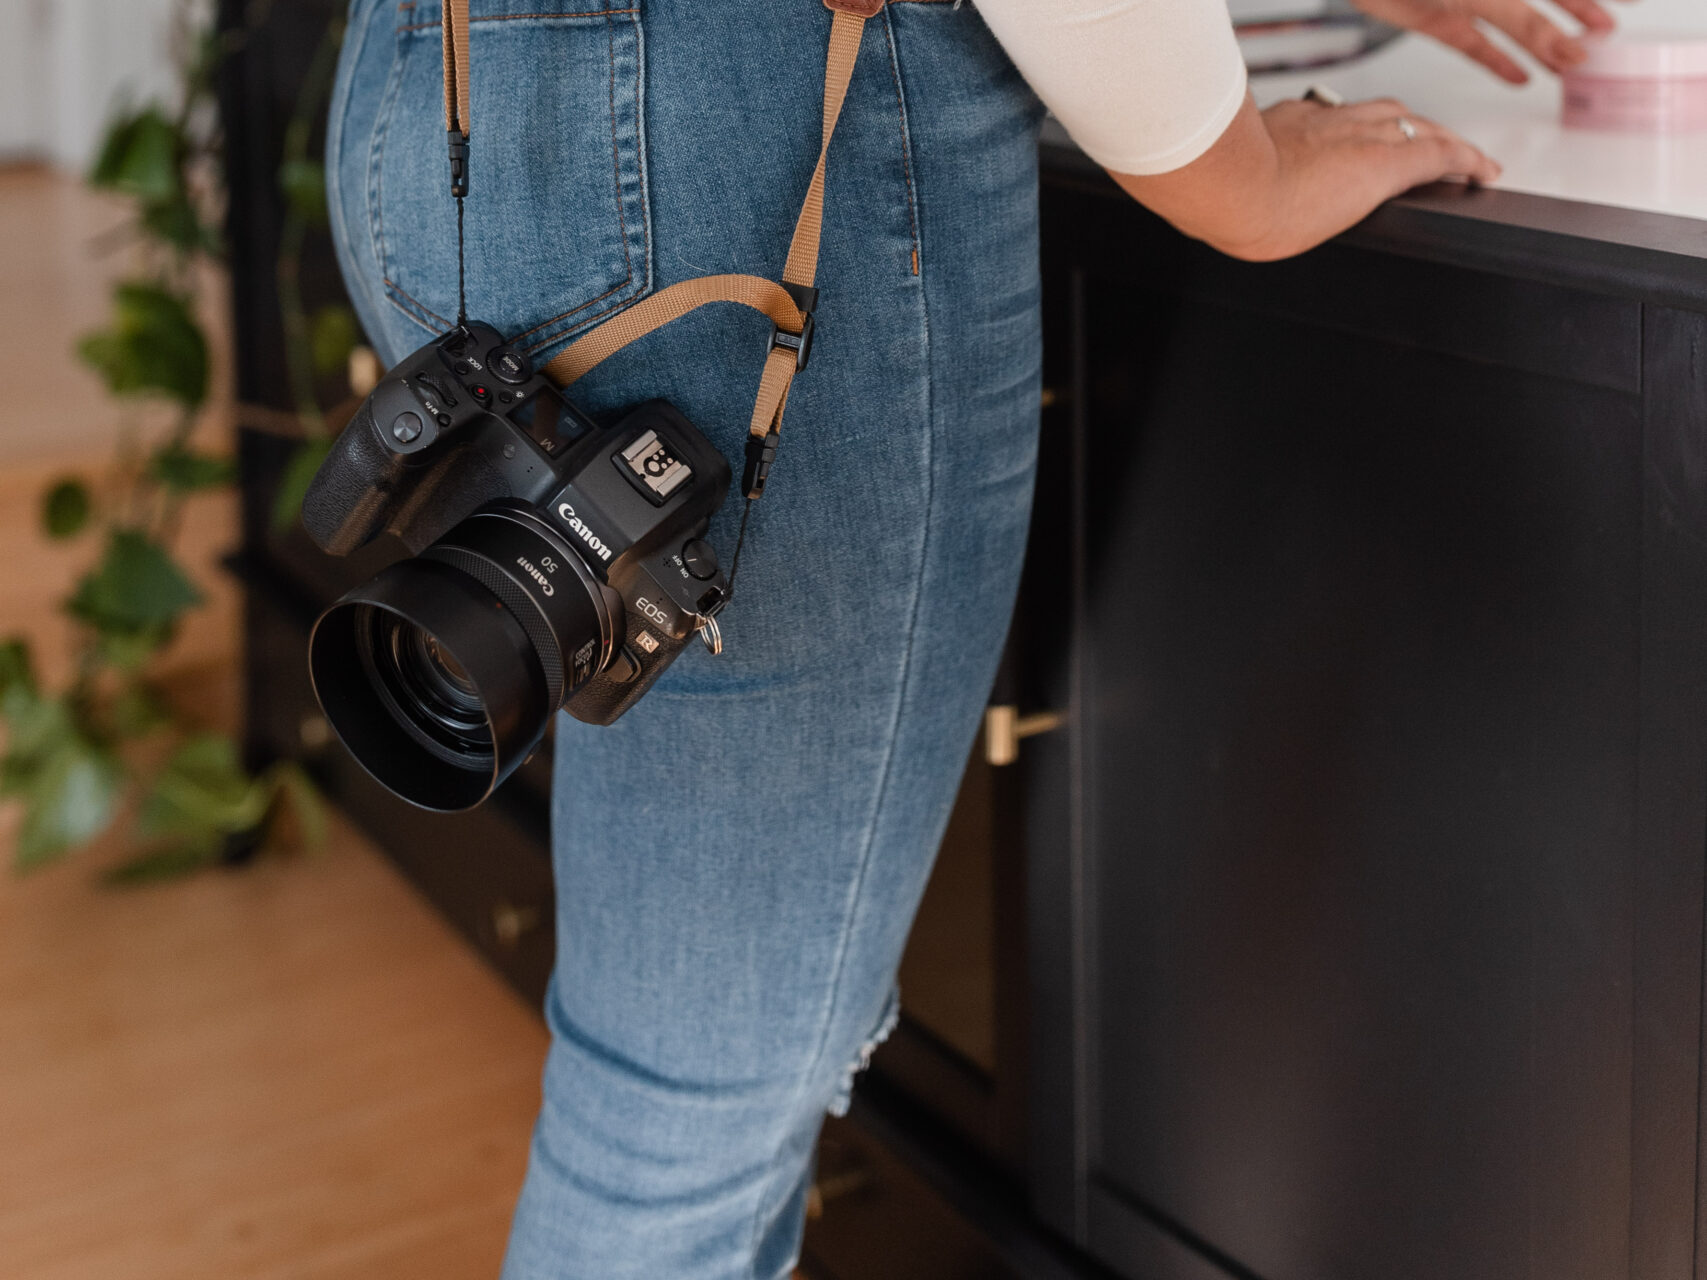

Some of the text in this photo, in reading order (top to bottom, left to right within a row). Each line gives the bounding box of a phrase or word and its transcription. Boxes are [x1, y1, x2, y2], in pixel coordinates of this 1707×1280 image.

[467, 356, 483, 371] LOCK
[502, 355, 520, 371] MODE
[540, 438, 555, 452] M
[558, 502, 613, 561] Canon
[540, 556, 559, 574] 50
[671, 554, 690, 578] ON OFF
[516, 556, 555, 597] Canon
[635, 596, 668, 624] EOS
